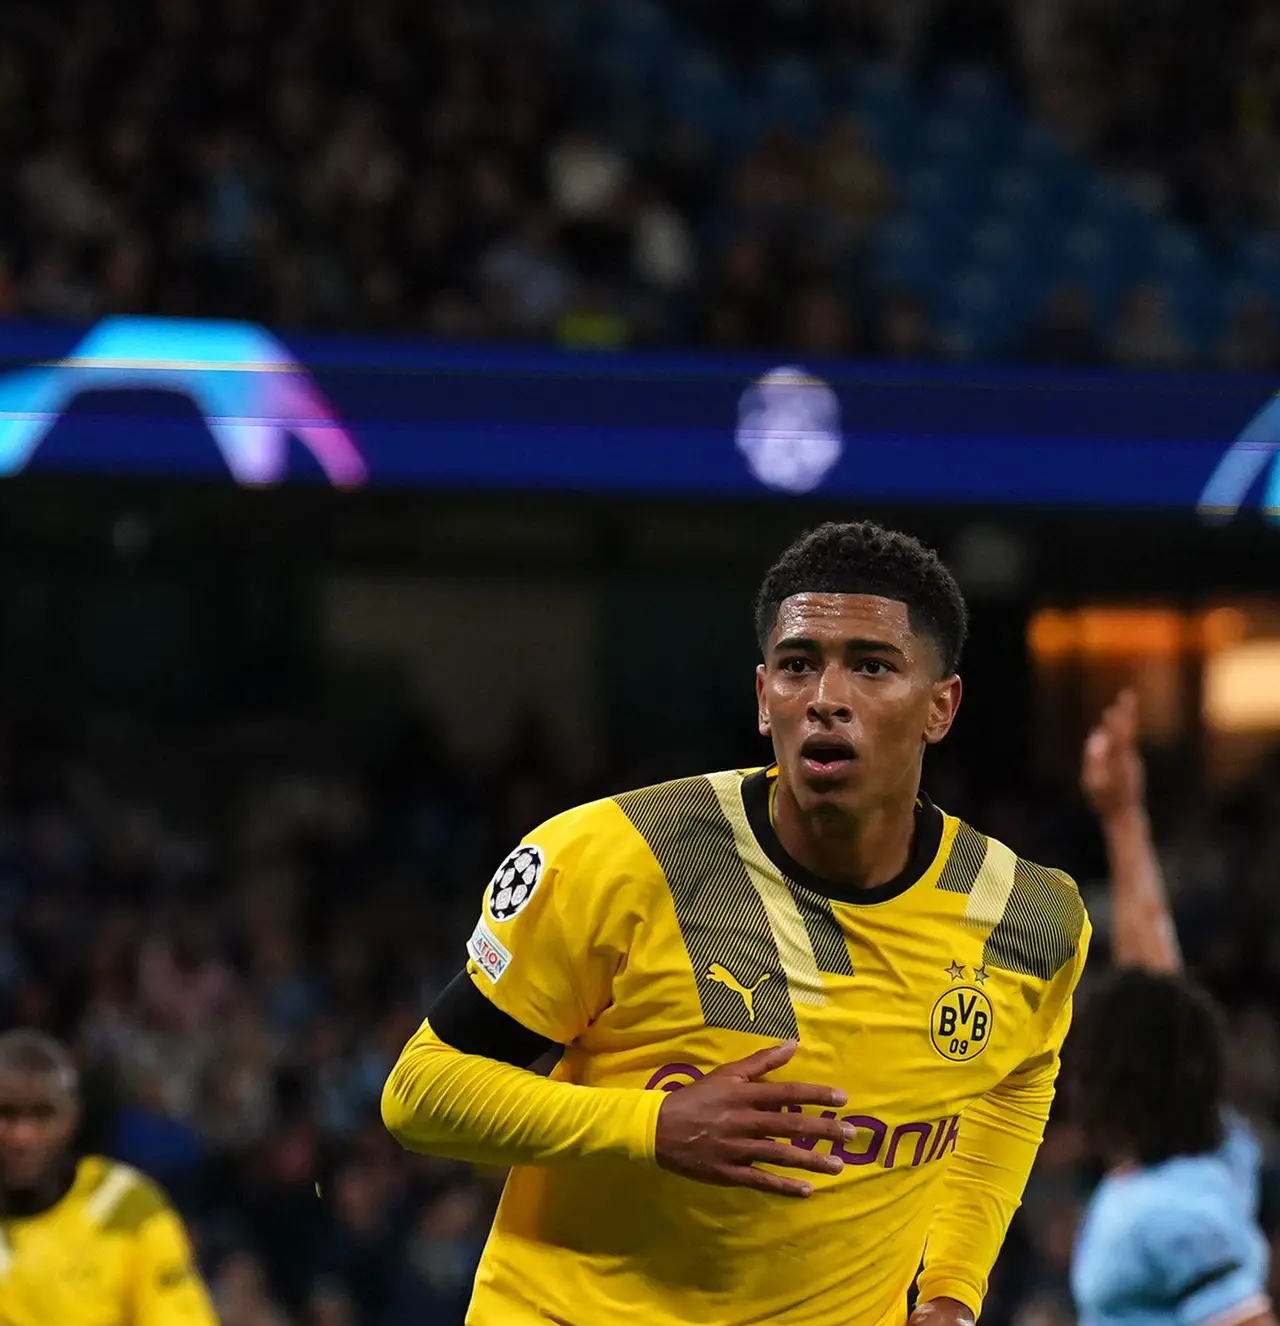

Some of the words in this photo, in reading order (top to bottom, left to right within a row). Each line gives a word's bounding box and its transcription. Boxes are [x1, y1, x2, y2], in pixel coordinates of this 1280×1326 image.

[938, 993, 988, 1041] BVB
[949, 1038, 969, 1055] 09
[768, 1105, 962, 1168] vonik
